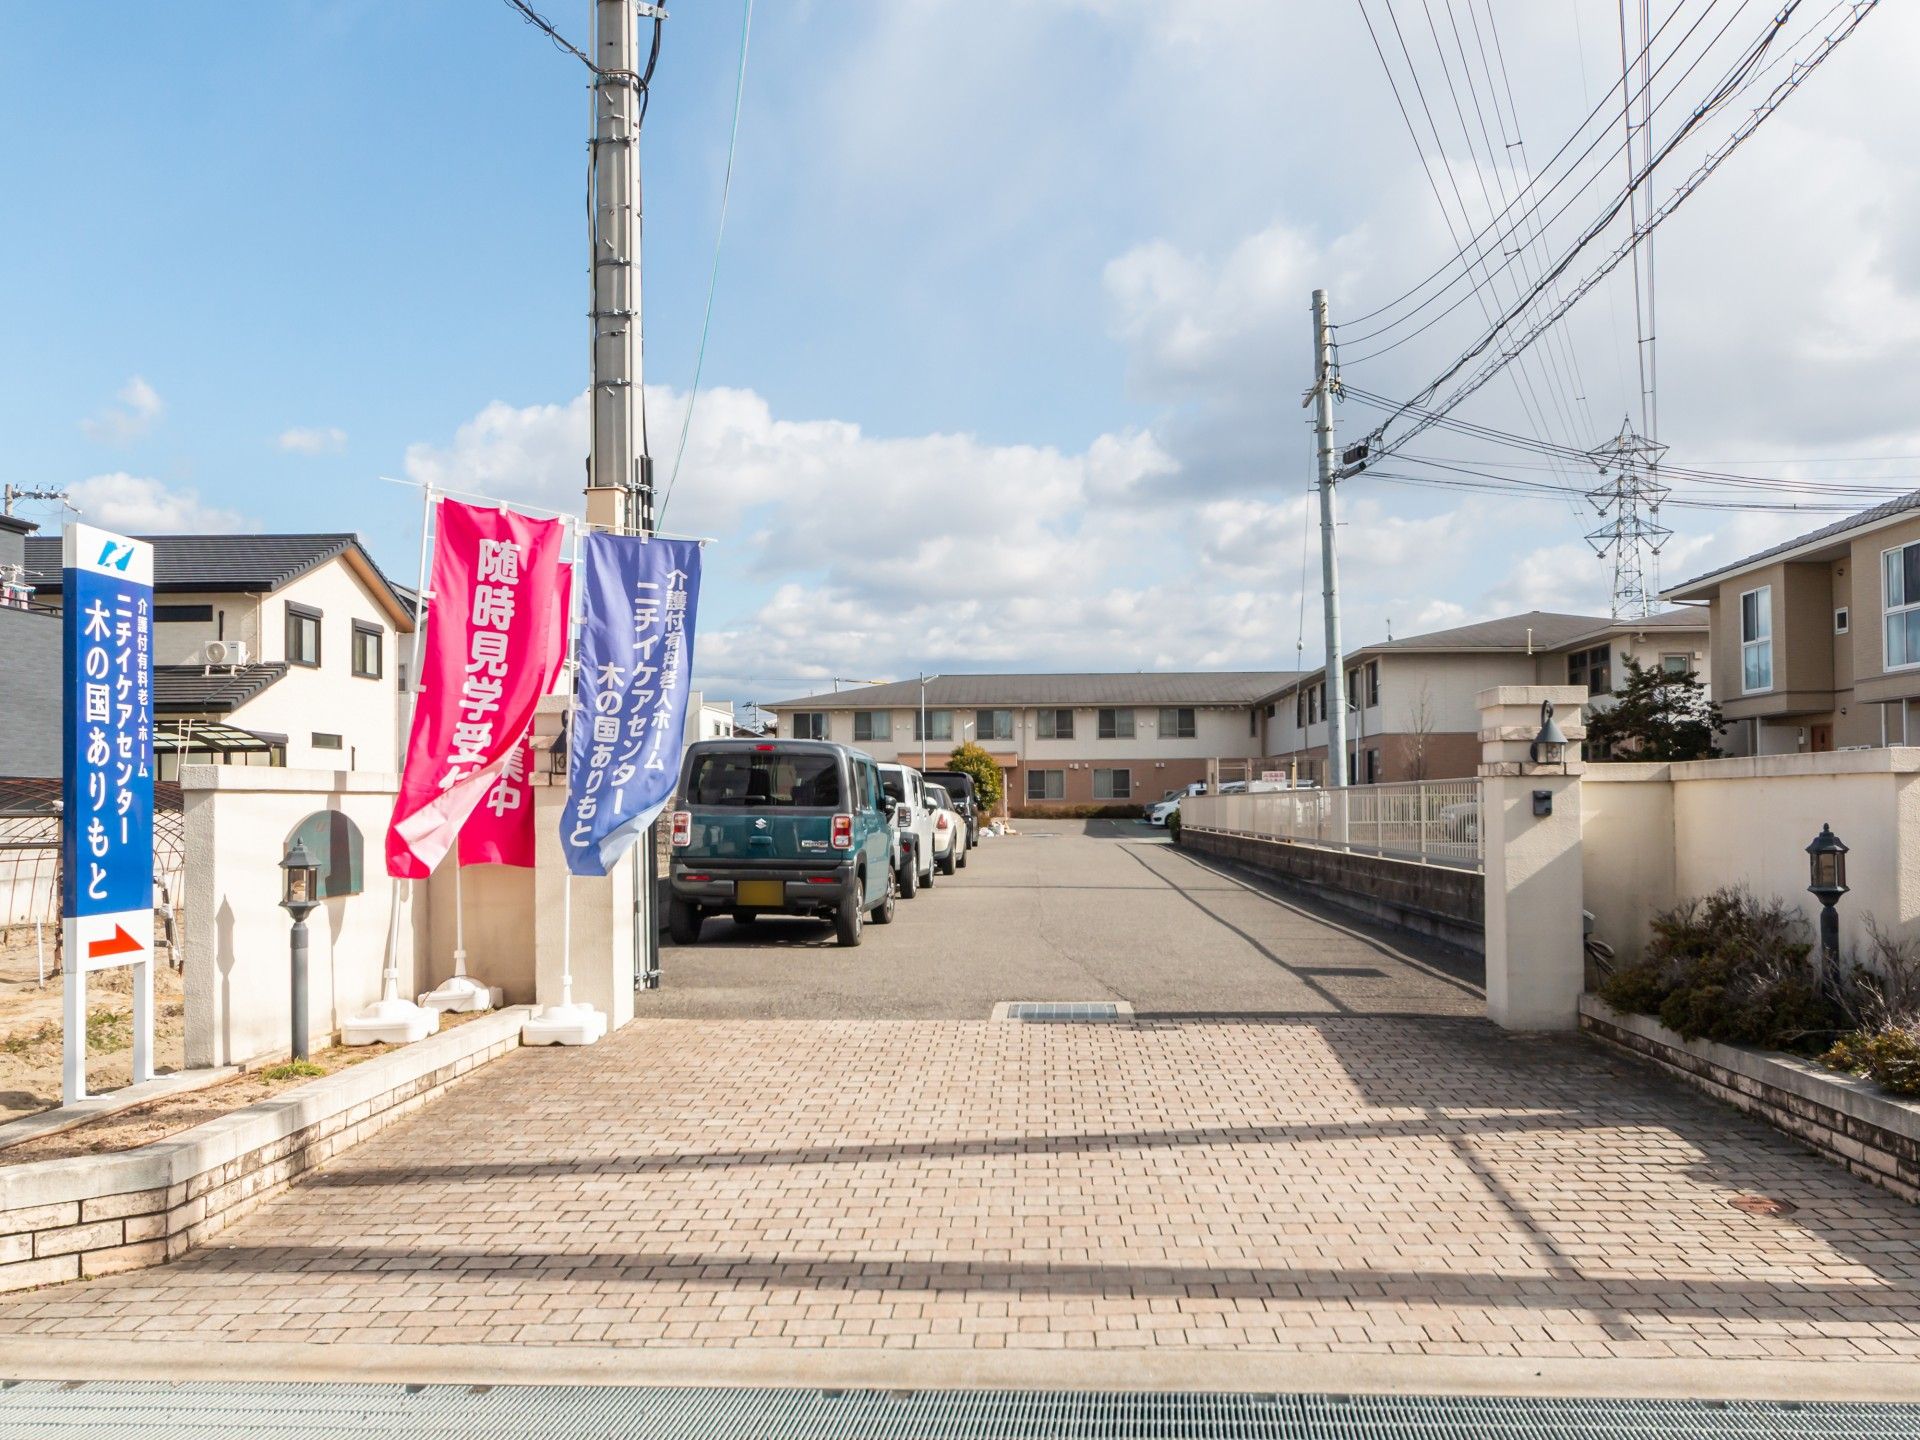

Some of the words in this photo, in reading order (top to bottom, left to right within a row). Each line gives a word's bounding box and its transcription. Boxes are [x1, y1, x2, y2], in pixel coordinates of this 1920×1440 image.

[84, 598, 111, 900] 木の国ありもと
[115, 593, 133, 845] ニチイケアセンター
[137, 597, 149, 778] 介護付有料老人ホーム
[569, 661, 626, 847] 木の国ありもと
[611, 581, 661, 815] ニチイケアセンター
[643, 568, 689, 771] 介護付有料老人ホーム
